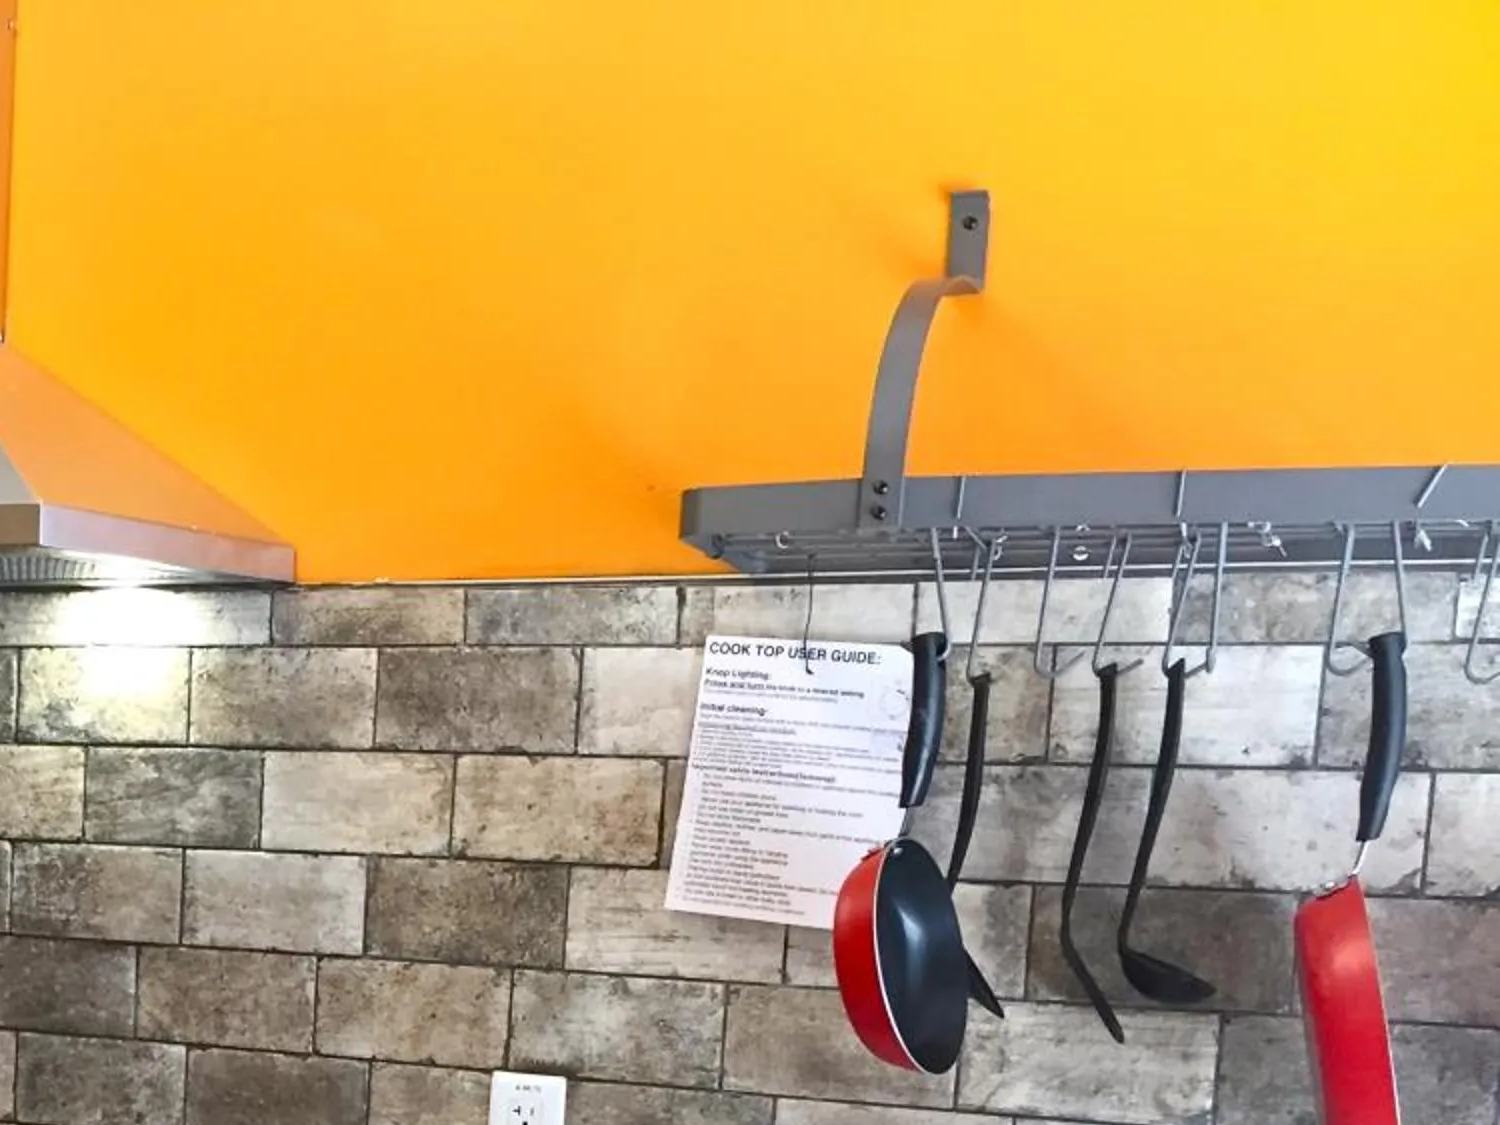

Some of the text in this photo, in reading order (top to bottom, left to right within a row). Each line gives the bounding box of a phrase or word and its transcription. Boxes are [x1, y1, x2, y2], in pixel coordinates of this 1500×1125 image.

[709, 641, 751, 657] COOK
[756, 644, 785, 657] TOP
[787, 646, 827, 660] USER
